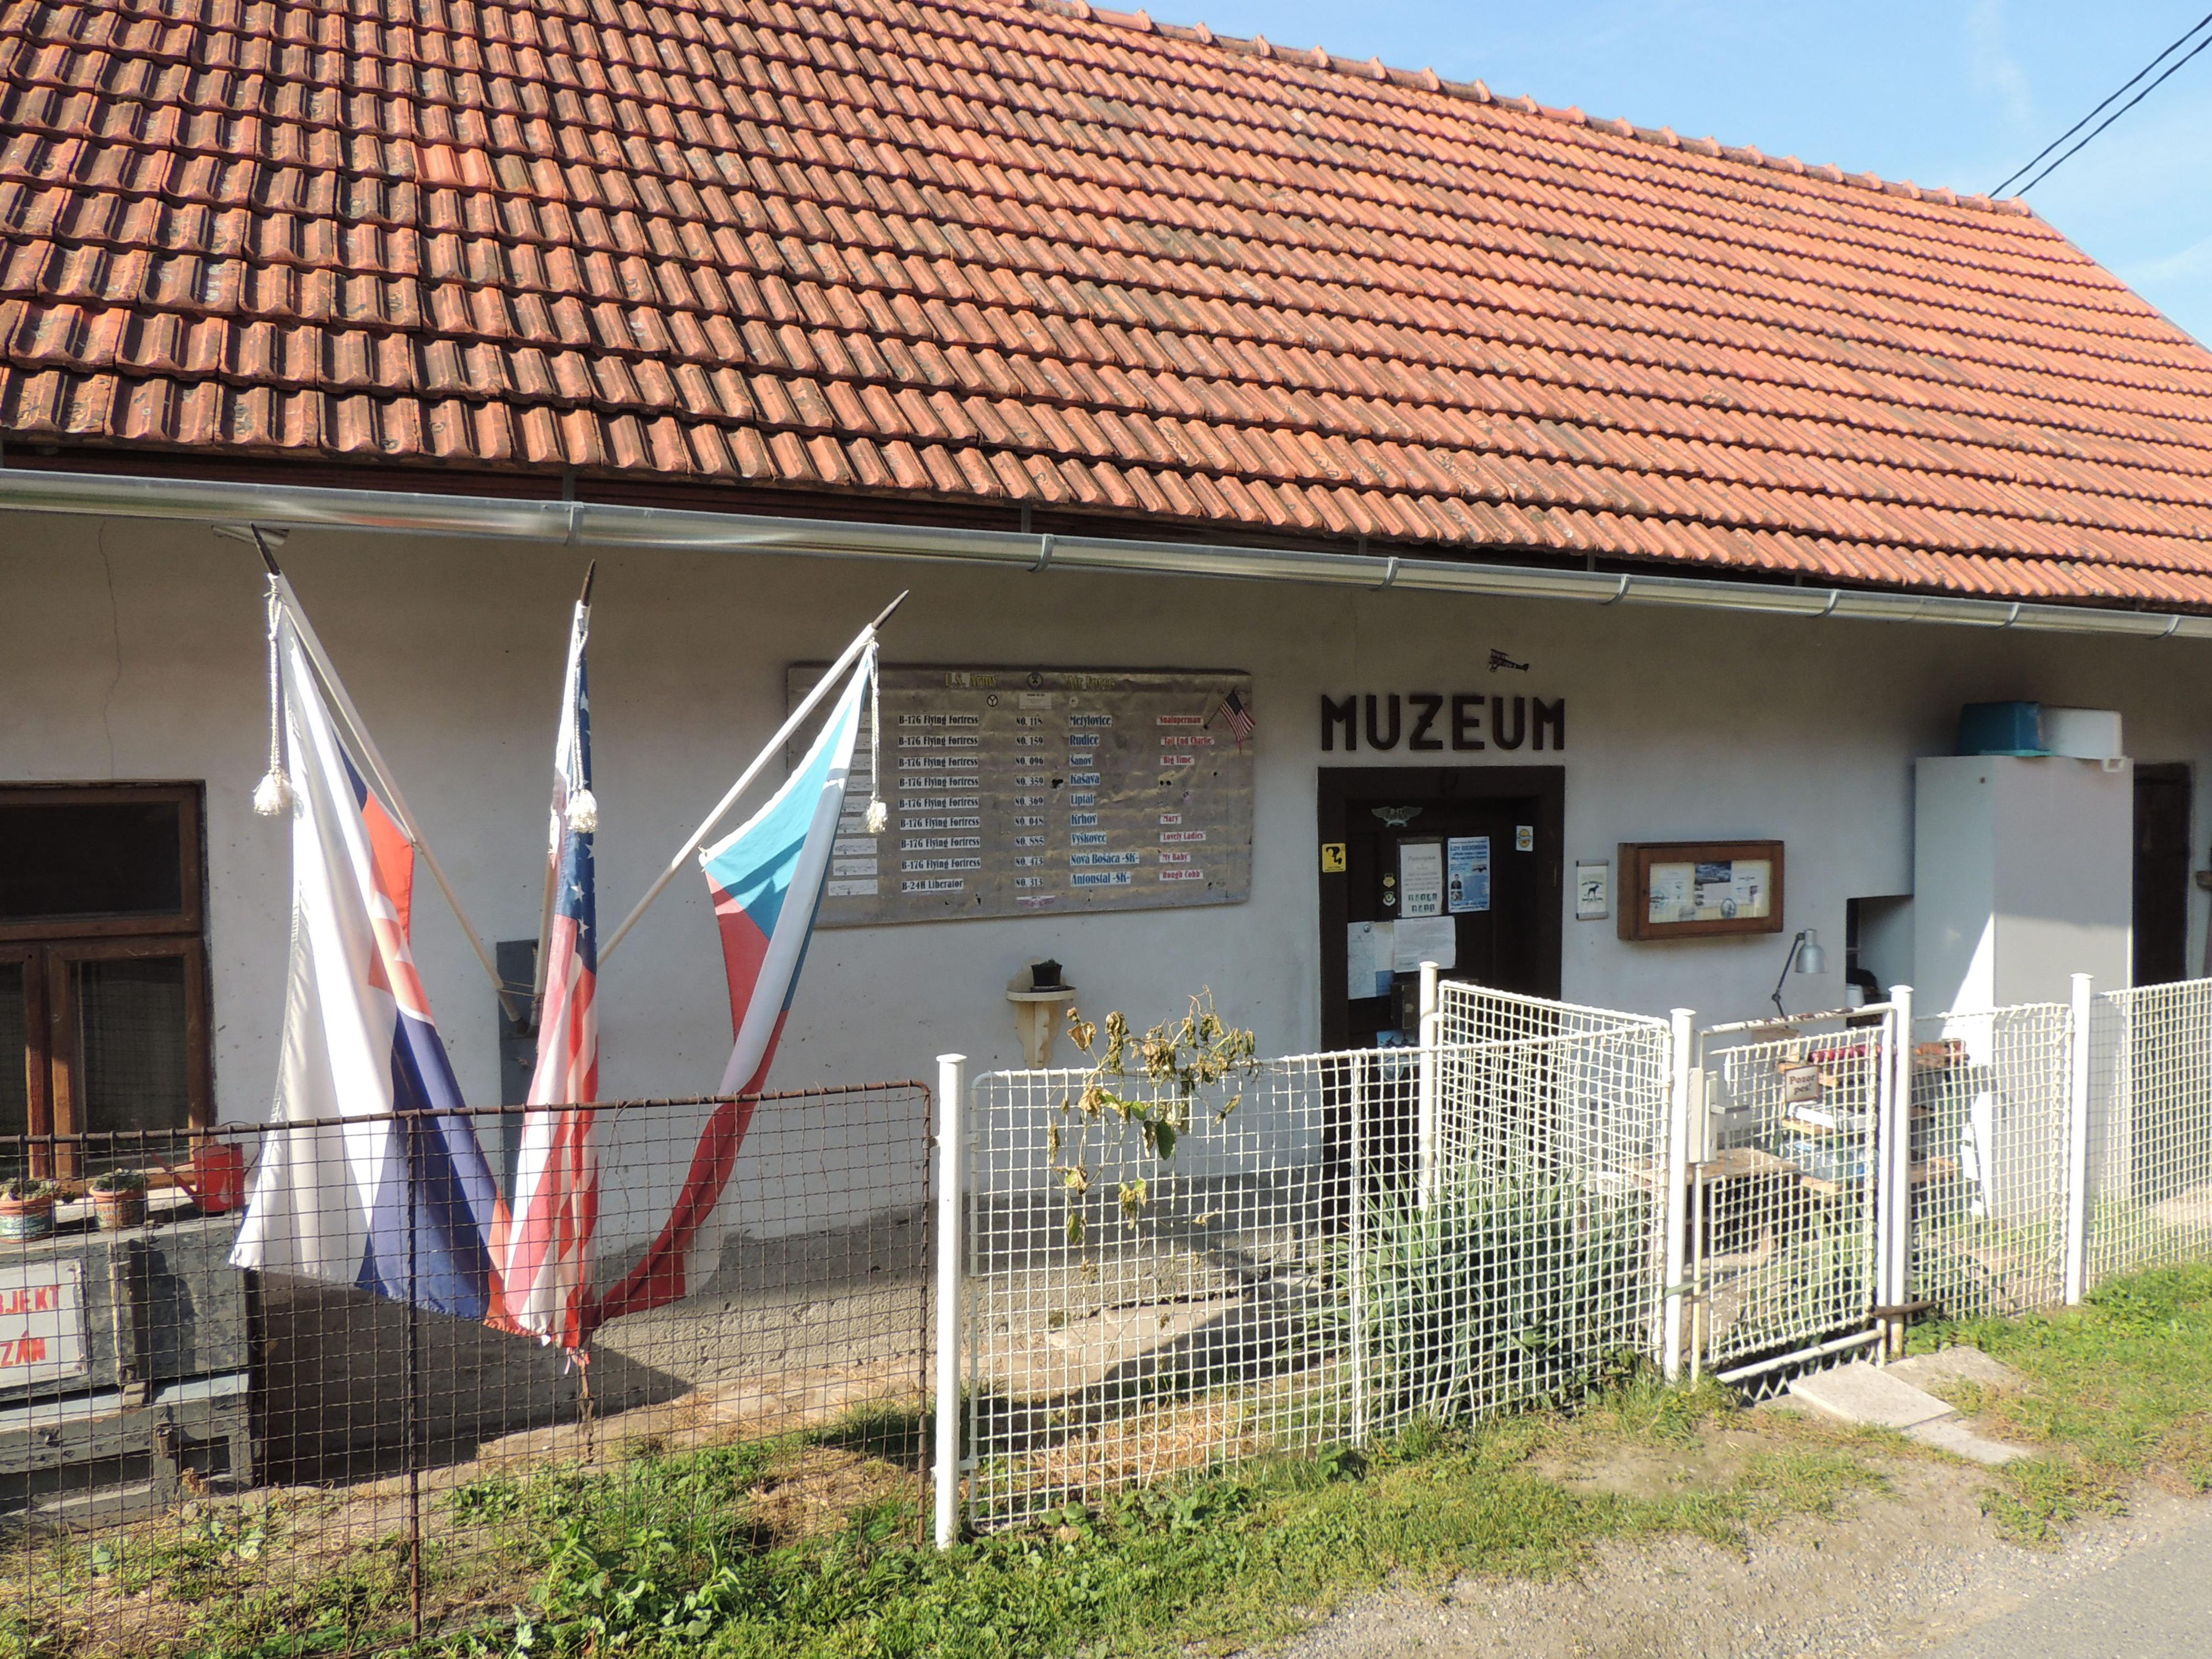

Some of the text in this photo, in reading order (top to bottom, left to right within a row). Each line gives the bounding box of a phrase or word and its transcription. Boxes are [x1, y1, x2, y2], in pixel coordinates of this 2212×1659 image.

[944, 673, 966, 687] U.S.
[969, 674, 997, 687] Army
[899, 715, 979, 725] B-17G Flying Fortress
[1321, 694, 1565, 751] MUZEUM
[899, 736, 978, 747] B-17G Flying Fortress
[1030, 736, 1043, 745] 159
[1070, 734, 1099, 745] Rudice
[899, 757, 978, 768] B-17G Flying Fortress
[1029, 757, 1044, 765] 096
[899, 777, 979, 787] B-17G Flying Fortress
[1029, 777, 1043, 785] 359
[1070, 774, 1100, 785] Kašava
[899, 797, 979, 808] B-17G Flying Fortress
[1029, 796, 1043, 805] 369
[1071, 794, 1093, 806] Liptál
[901, 817, 980, 828] B-17G Flying Fortress
[1071, 813, 1096, 825] Krhov
[1071, 833, 1106, 845] Vyškovec
[1163, 832, 1203, 841] Lovely Ladies
[901, 837, 980, 848] B-17G Flying Fortress
[902, 859, 980, 870] B-17G Flying Fortress
[1030, 857, 1043, 865] 473
[1071, 853, 1138, 865] Nová Bošáca -SK-
[1030, 878, 1043, 886] 313
[1112, 872, 1130, 883] -SK-
[902, 879, 963, 890] B-24H Liberator
[1789, 1074, 1815, 1084] Pozor
